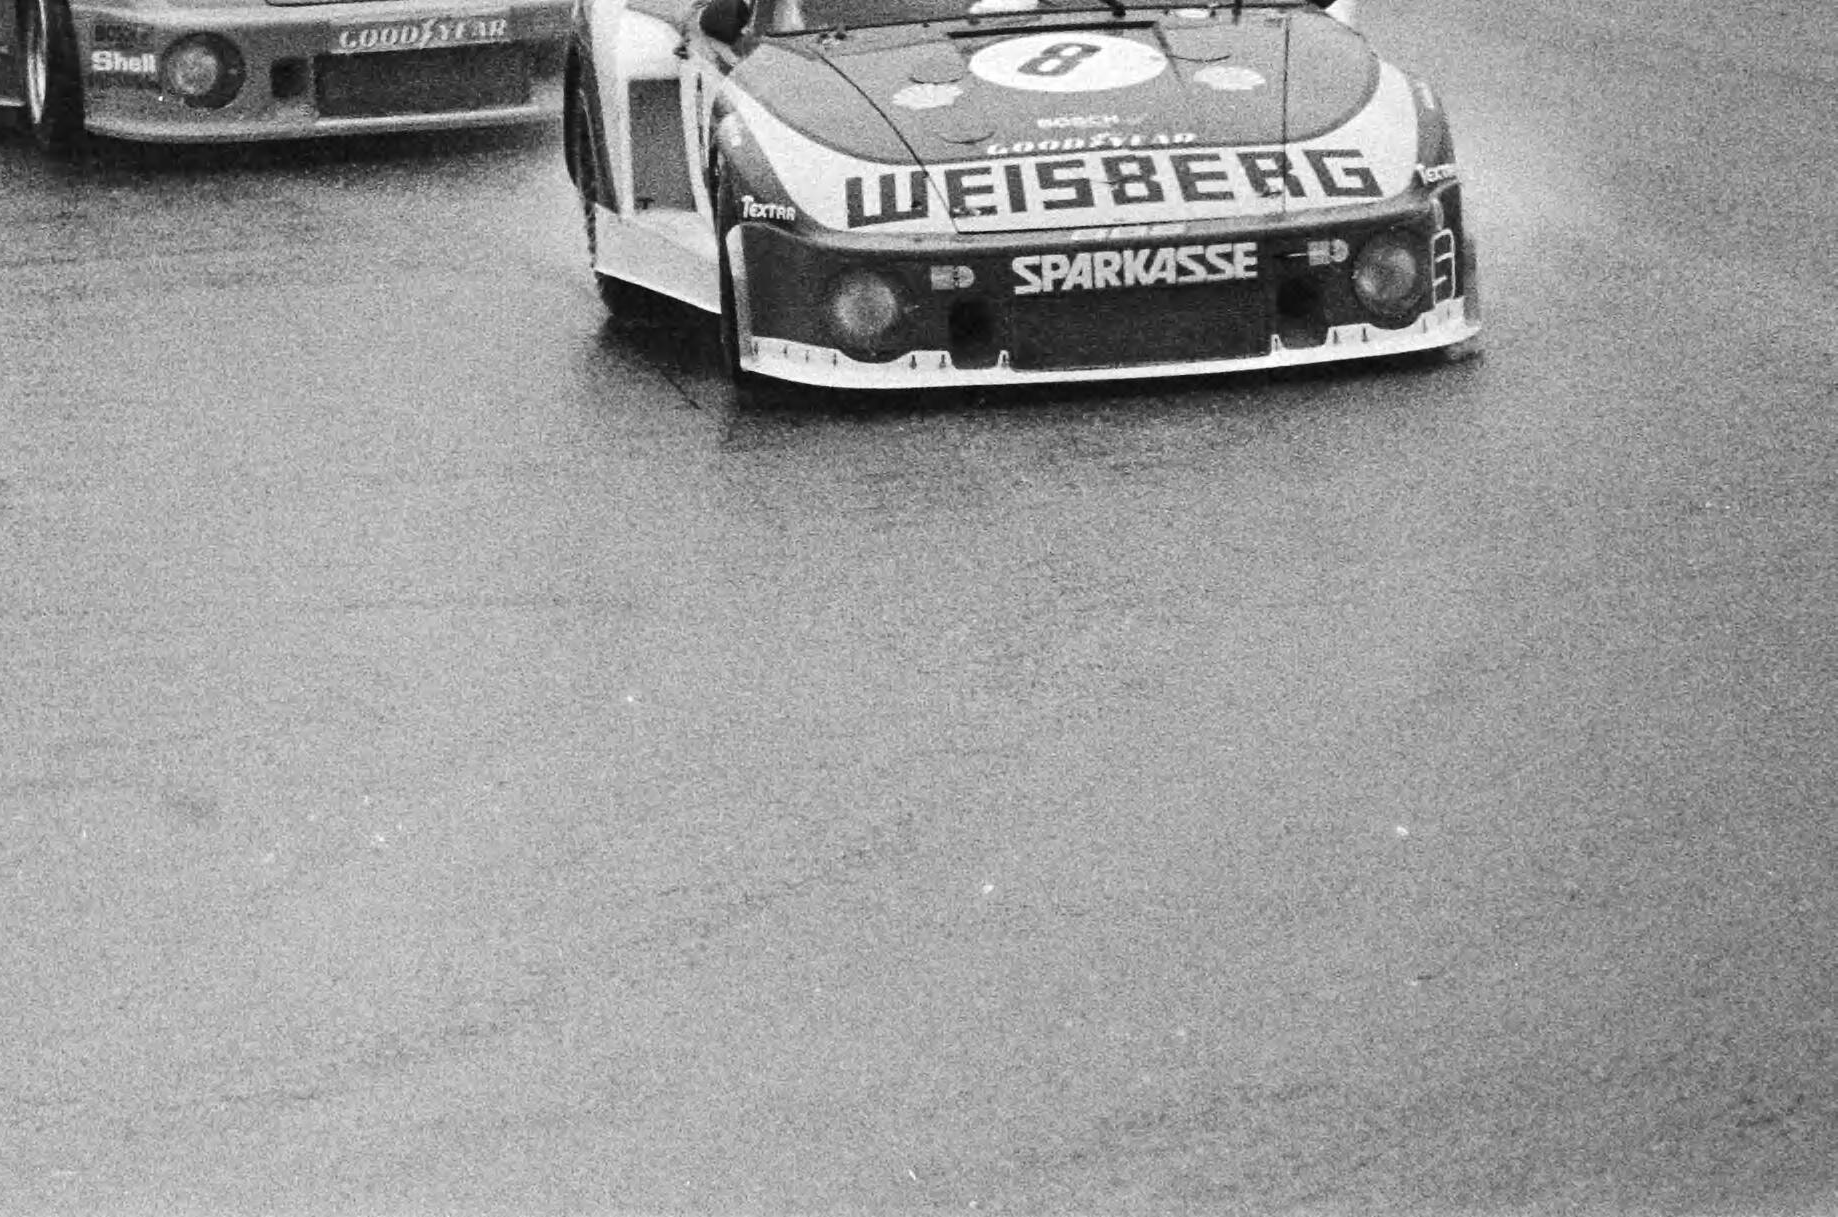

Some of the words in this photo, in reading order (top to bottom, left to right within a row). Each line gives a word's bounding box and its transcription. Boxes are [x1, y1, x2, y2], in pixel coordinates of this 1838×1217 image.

[338, 17, 508, 50] GOODYEAR
[90, 49, 158, 74] Shell
[1017, 41, 1103, 77] 8
[986, 132, 1197, 156] GOODYEAR
[844, 148, 1385, 229] WEISBERG
[1011, 241, 1259, 295] SPARKASSE
